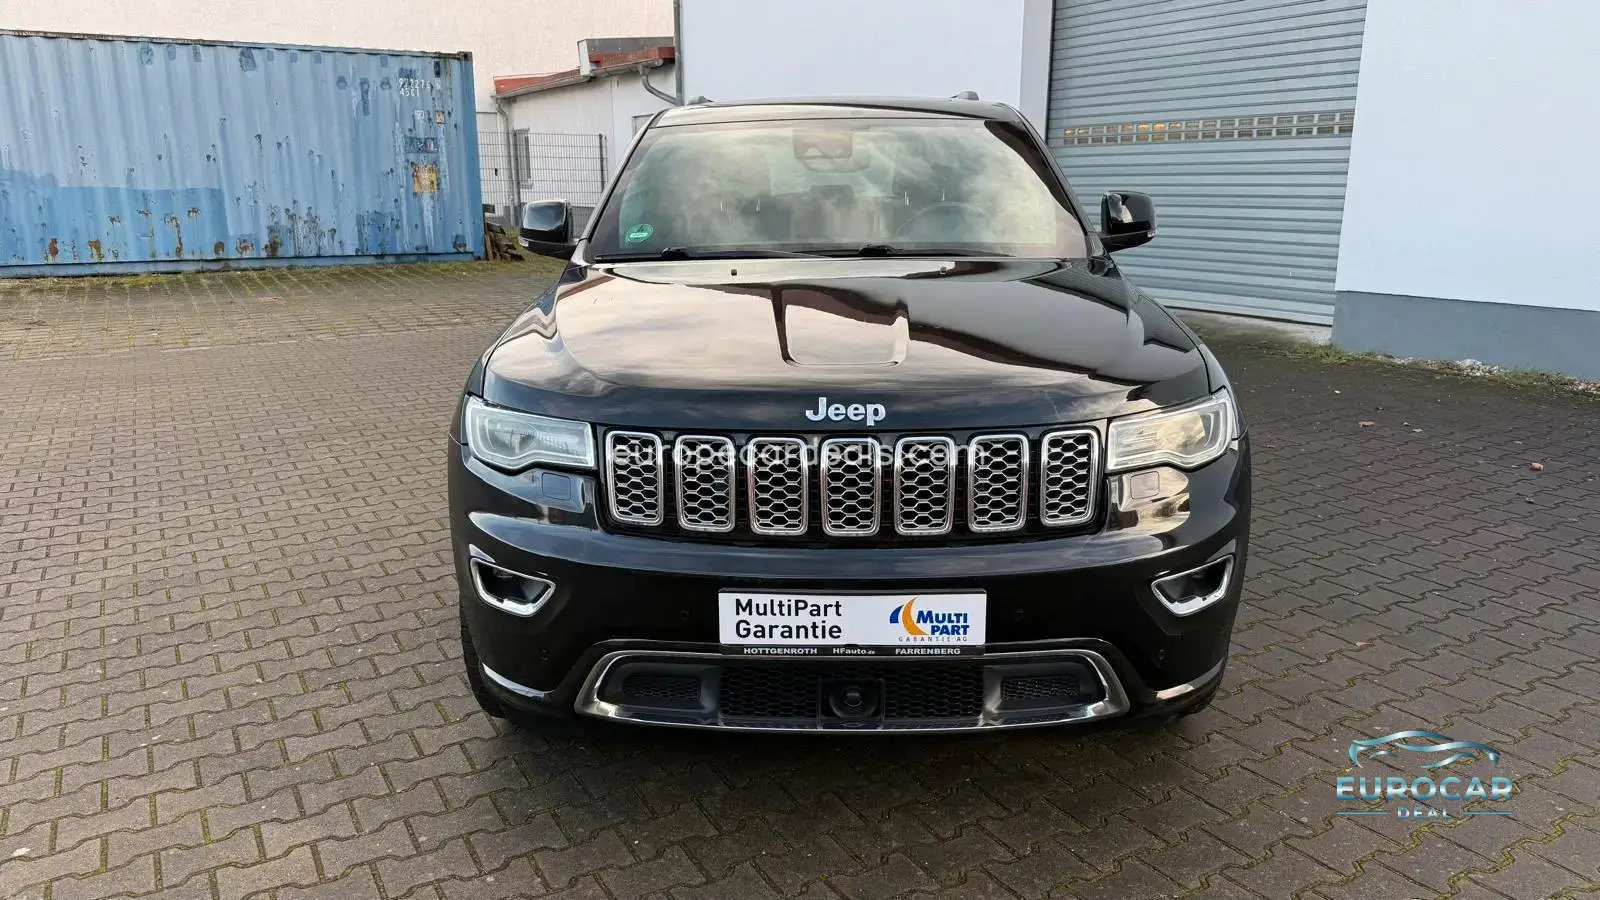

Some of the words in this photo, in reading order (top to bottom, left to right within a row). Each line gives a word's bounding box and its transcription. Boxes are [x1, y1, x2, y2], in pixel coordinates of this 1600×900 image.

[805, 396, 886, 427] Jeep
[735, 598, 842, 617] MultiPart
[735, 619, 842, 639] Garantie
[930, 624, 970, 636] PART
[743, 647, 818, 655] HOTTGENROTH
[832, 647, 876, 655] HFauto.de
